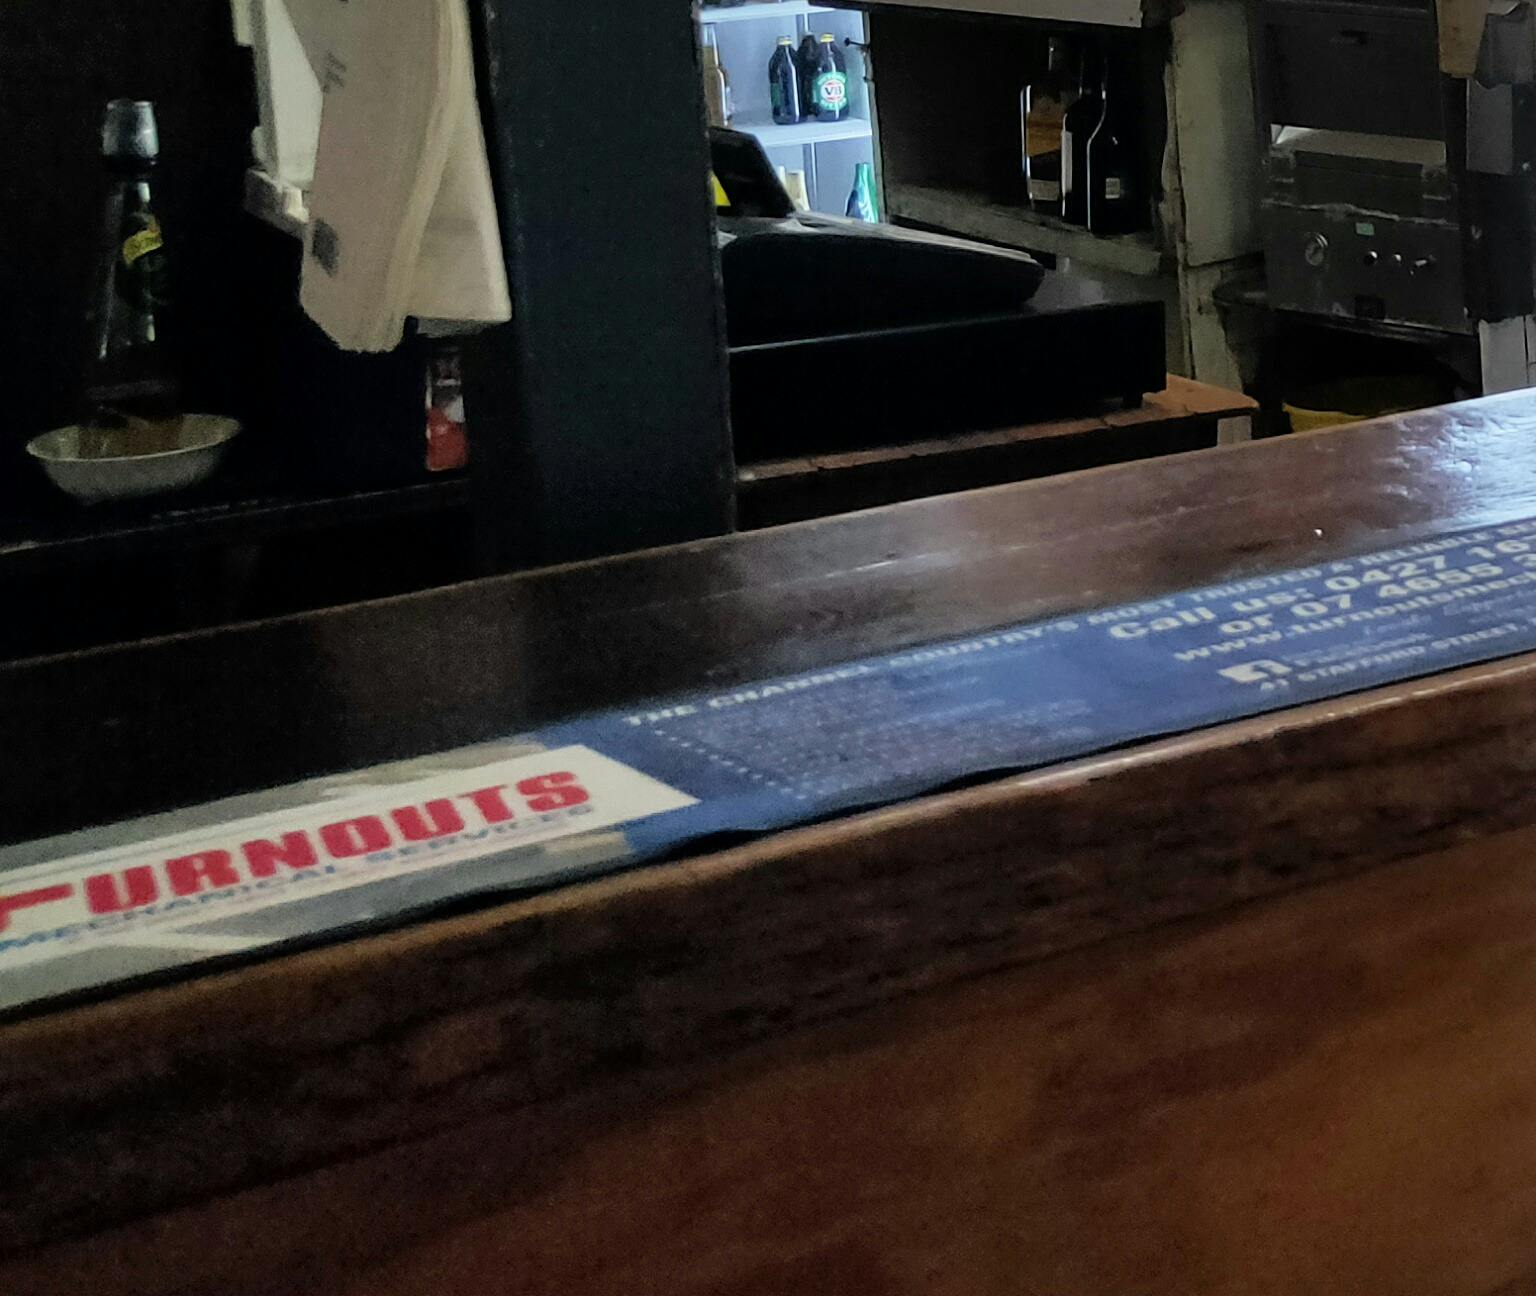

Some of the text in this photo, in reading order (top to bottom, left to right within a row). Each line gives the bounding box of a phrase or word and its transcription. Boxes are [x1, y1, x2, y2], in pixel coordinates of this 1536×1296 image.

[1108, 592, 1218, 644] Call
[1227, 586, 1318, 613] us:
[1315, 554, 1465, 592] 0427
[1213, 612, 1283, 635] or
[1284, 593, 1368, 618] 07
[1363, 561, 1513, 599] 4655
